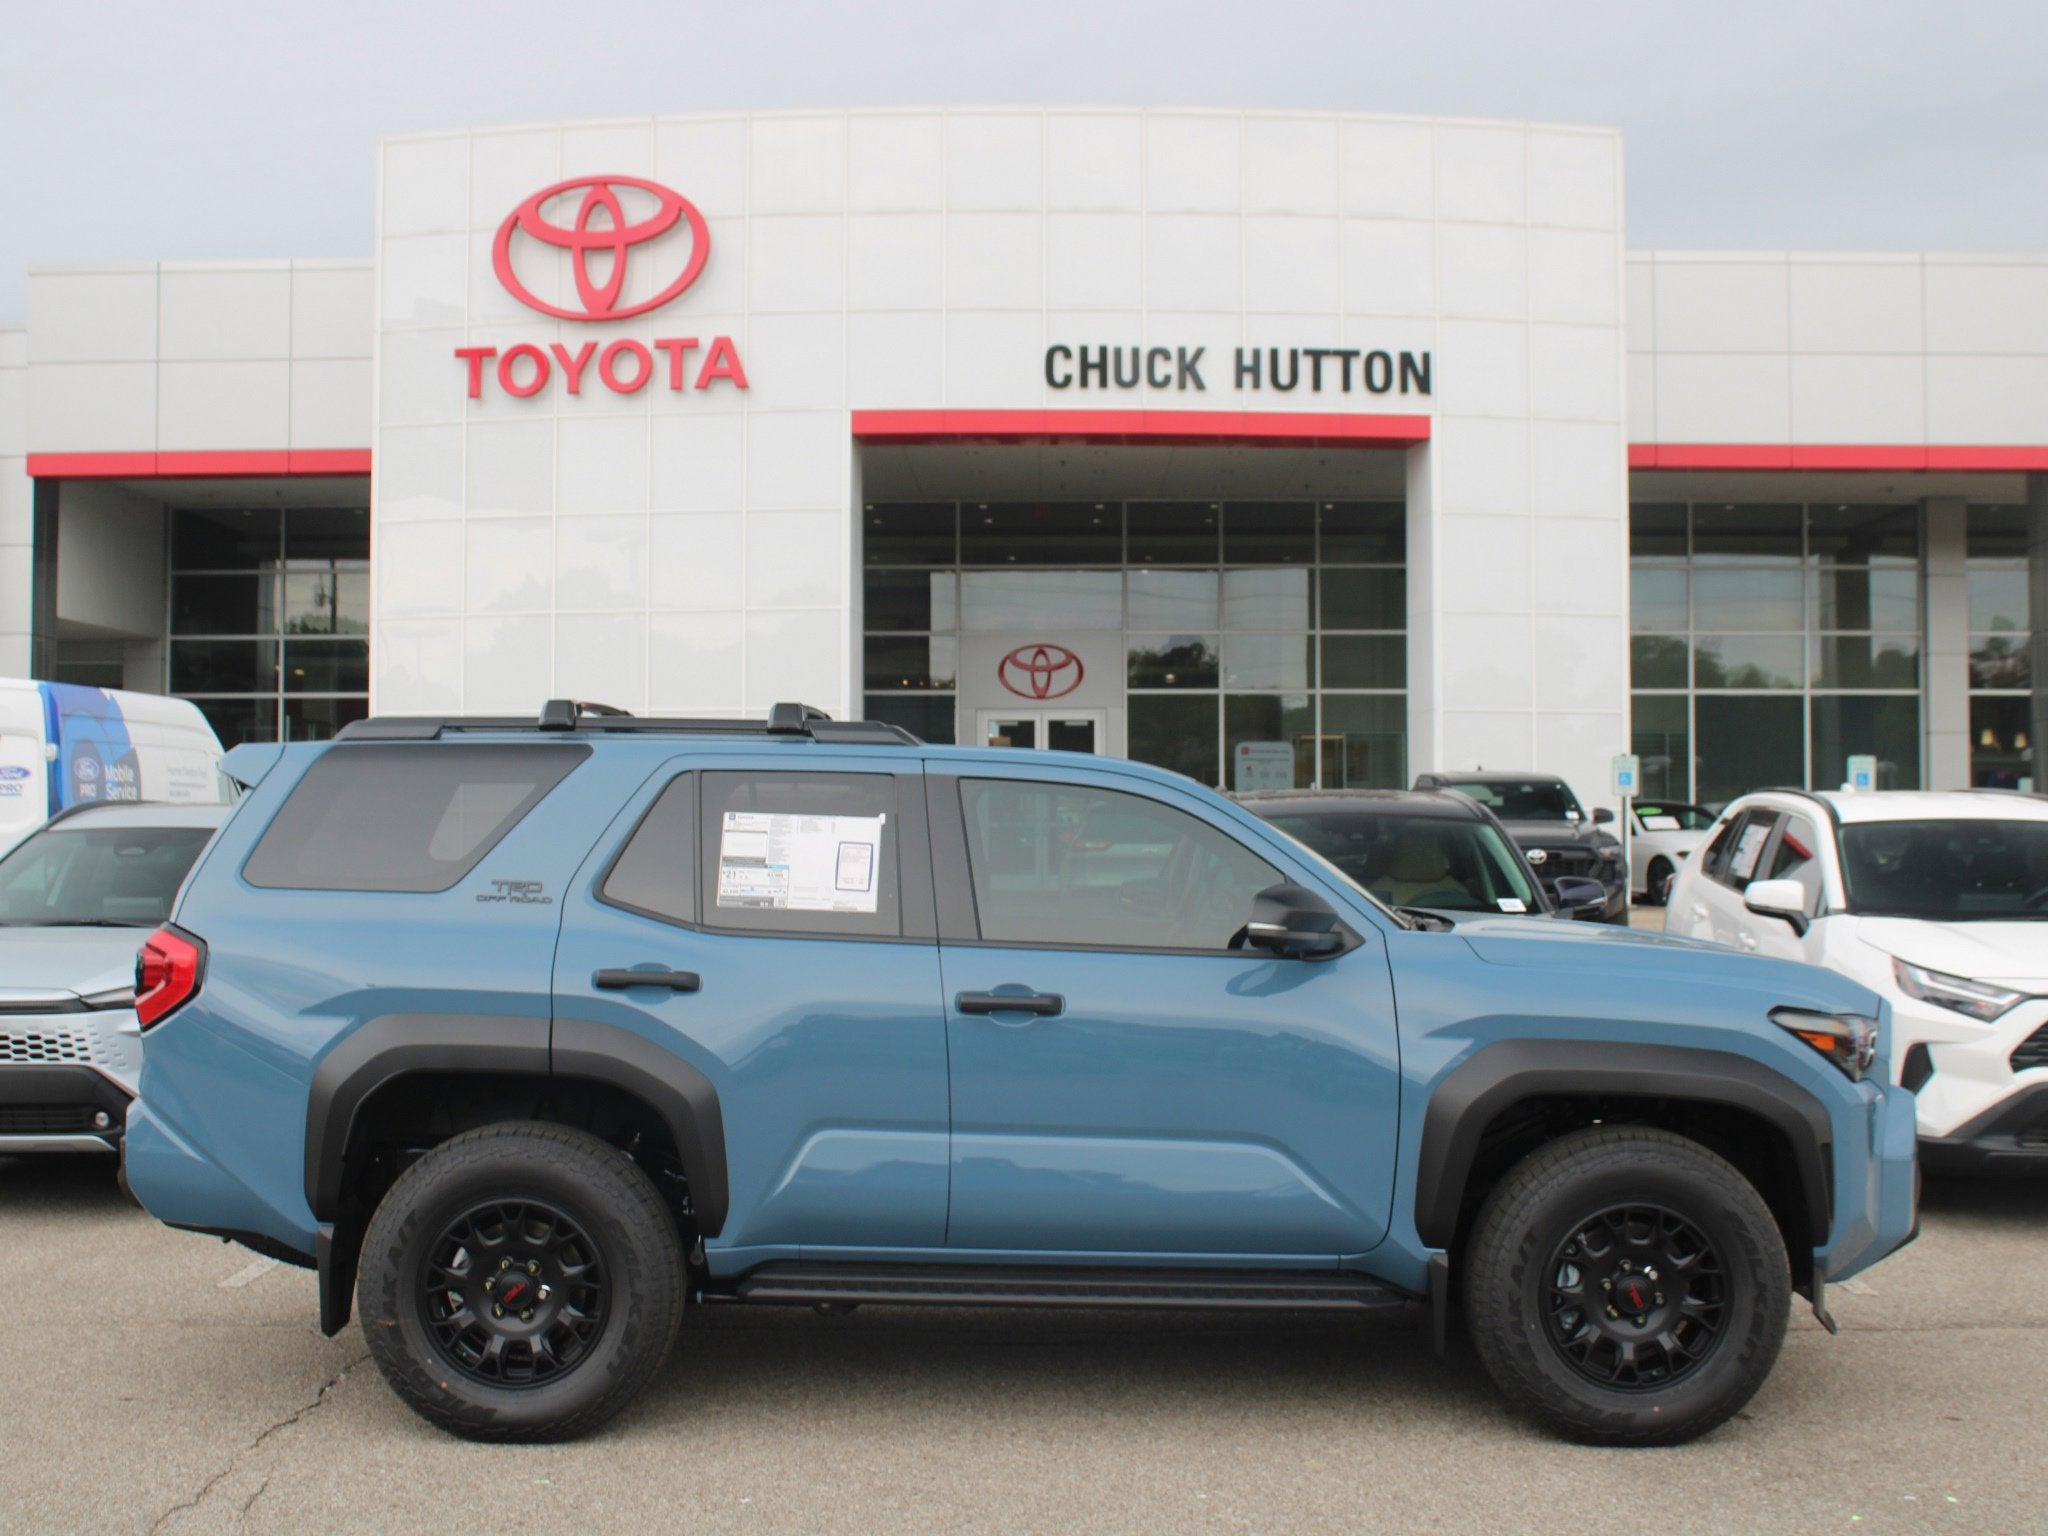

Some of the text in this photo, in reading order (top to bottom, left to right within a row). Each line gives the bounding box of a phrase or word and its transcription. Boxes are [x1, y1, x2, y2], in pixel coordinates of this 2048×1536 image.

[454, 335, 749, 399] TOYOTA
[1045, 344, 1432, 396] CHUCK HUTTON
[105, 764, 134, 783] Mobile
[80, 783, 97, 797] PRO
[105, 782, 137, 800] Service
[491, 880, 543, 898] TRD
[476, 894, 553, 904] OFF ROAD
